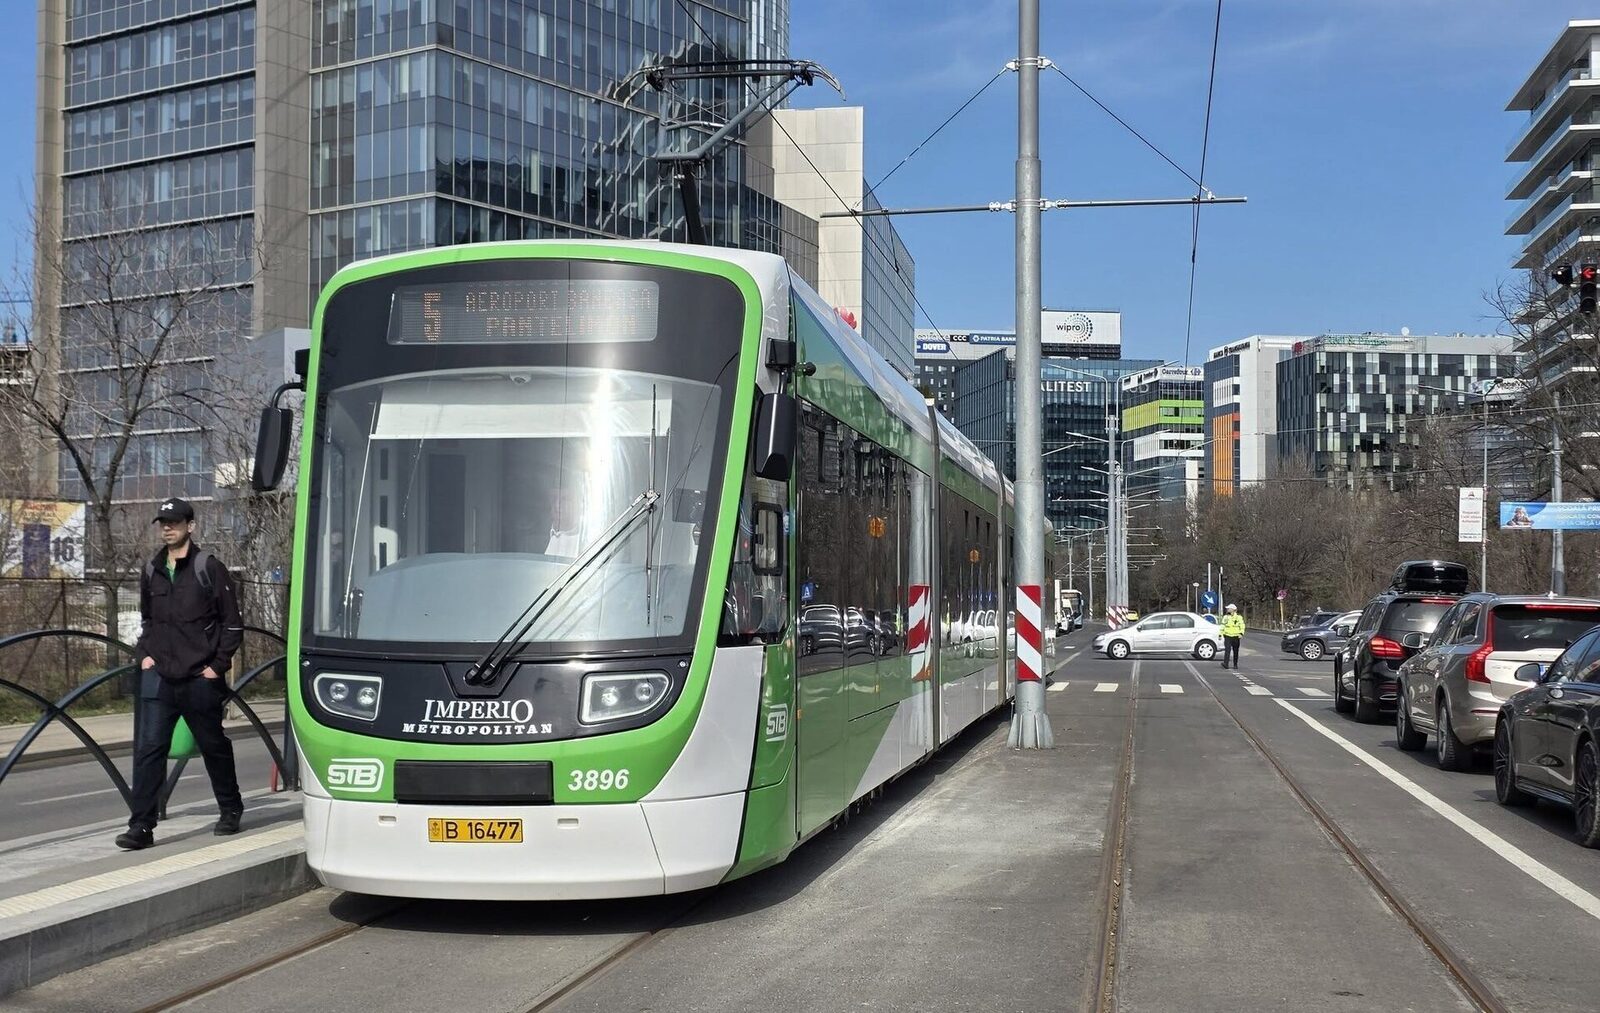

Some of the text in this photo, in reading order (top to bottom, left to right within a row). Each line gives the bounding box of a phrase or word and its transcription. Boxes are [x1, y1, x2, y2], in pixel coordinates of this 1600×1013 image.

[465, 290, 558, 312] AEROPORT
[423, 292, 441, 341] 5
[1056, 322, 1080, 333] wipro
[922, 343, 946, 351] DOVER
[421, 699, 534, 723] IMPERIO
[402, 723, 553, 735] METROPOLITAN
[327, 762, 380, 788] STB
[567, 768, 631, 791] 3896
[446, 821, 520, 841] B 16477
